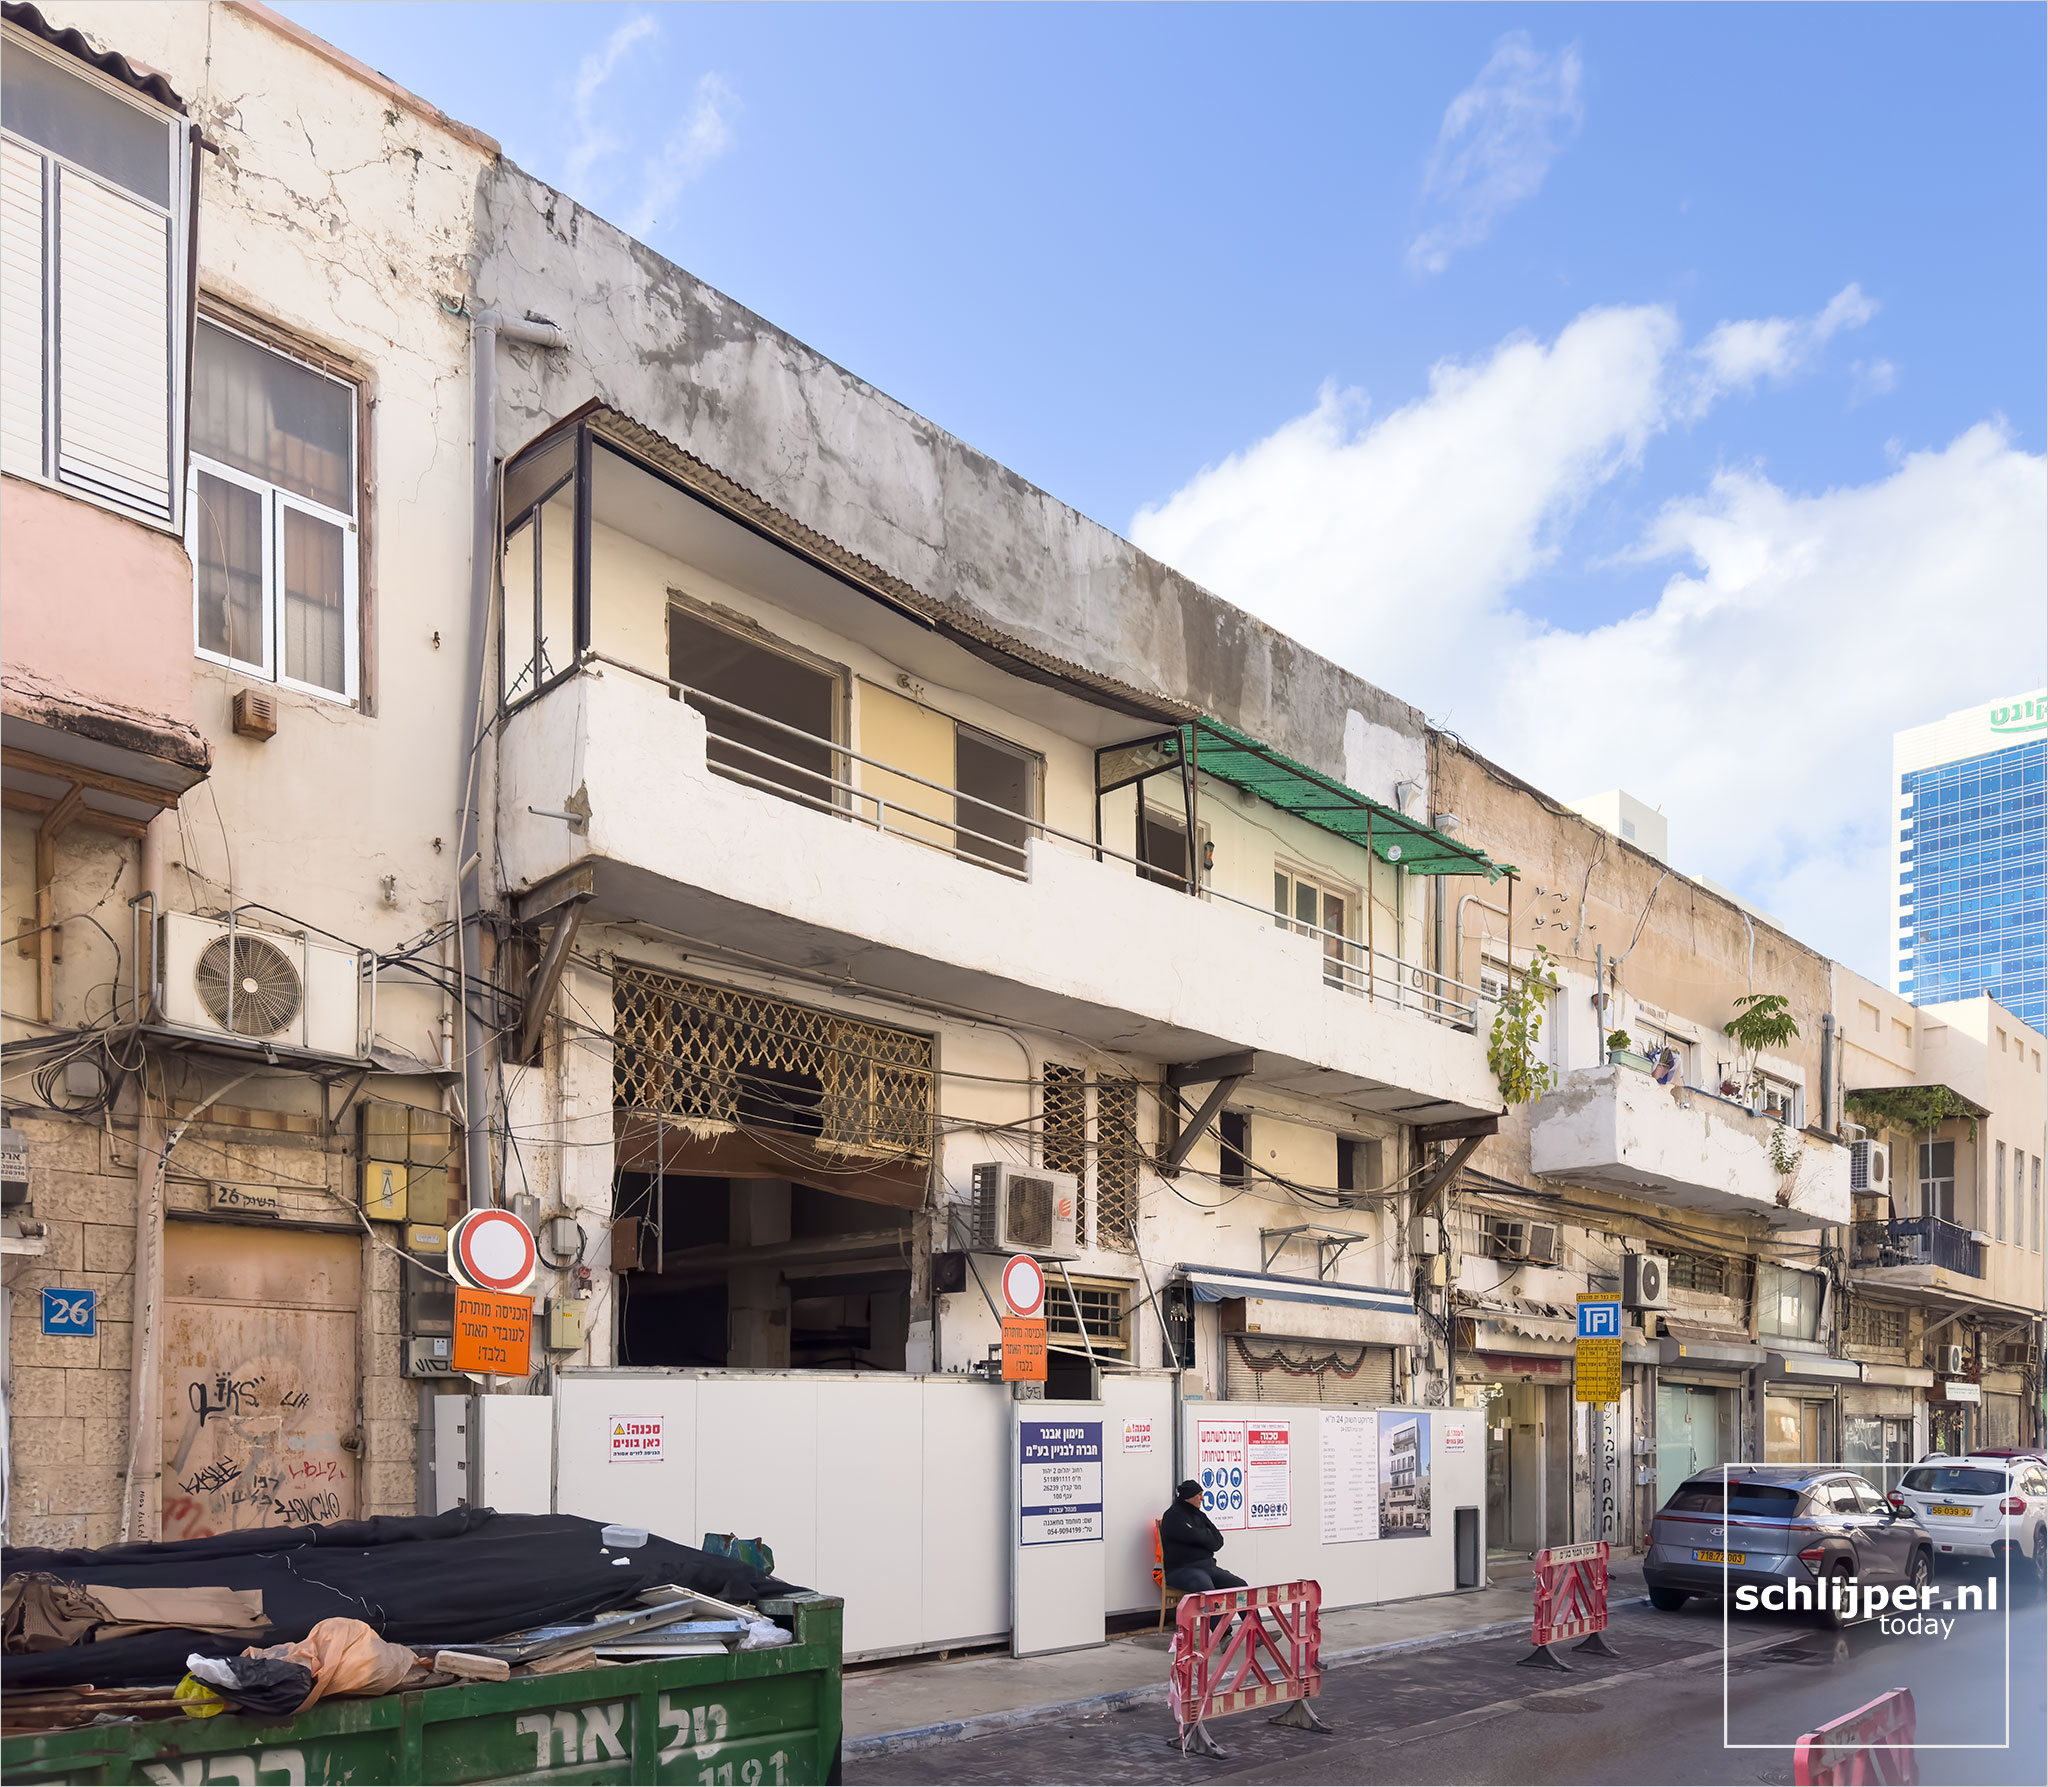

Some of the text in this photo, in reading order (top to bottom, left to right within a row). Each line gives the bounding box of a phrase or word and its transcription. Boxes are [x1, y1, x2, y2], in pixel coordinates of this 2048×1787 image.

[218, 1187, 276, 1208] השוק 26
[50, 1298, 89, 1326] 26
[460, 1300, 528, 1321] הכניסה מותרת
[462, 1323, 525, 1343] לעובדי האתר
[1004, 1327, 1044, 1338] הכניסה מותרת
[478, 1346, 507, 1362] בלבד!
[1006, 1344, 1043, 1355] לעובדי האתר
[1016, 1360, 1033, 1372] בלבד!
[1336, 1415, 1343, 1423] 24
[627, 1423, 660, 1435] סכנה!
[1040, 1428, 1085, 1442] מימון אבנר
[1260, 1431, 1278, 1440] סכנה
[1201, 1429, 1242, 1443] חובה להשתמש
[613, 1438, 660, 1449] כאן בונים
[1076, 1444, 1098, 1456] חברה
[1050, 1443, 1075, 1459] לבניין
[1226, 1450, 1242, 1462] בציוד
[516, 1695, 728, 1768] טל אור
